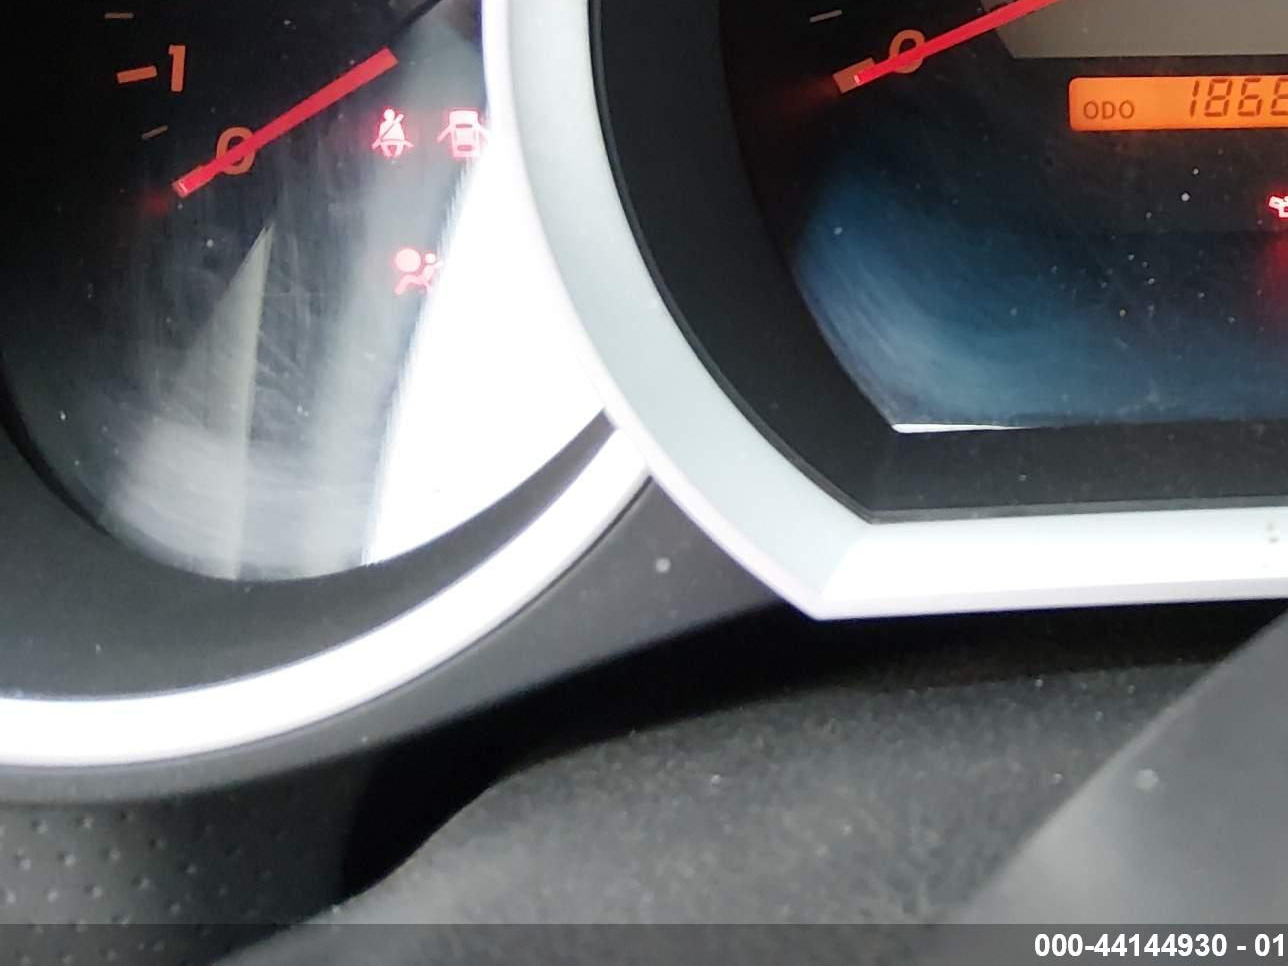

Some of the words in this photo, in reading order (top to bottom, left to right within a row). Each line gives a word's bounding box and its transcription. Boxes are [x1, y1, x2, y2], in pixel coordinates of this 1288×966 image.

[168, 44, 187, 92] 1
[889, 29, 926, 74] 0
[1083, 100, 1135, 120] ODO
[216, 127, 256, 175] 0
